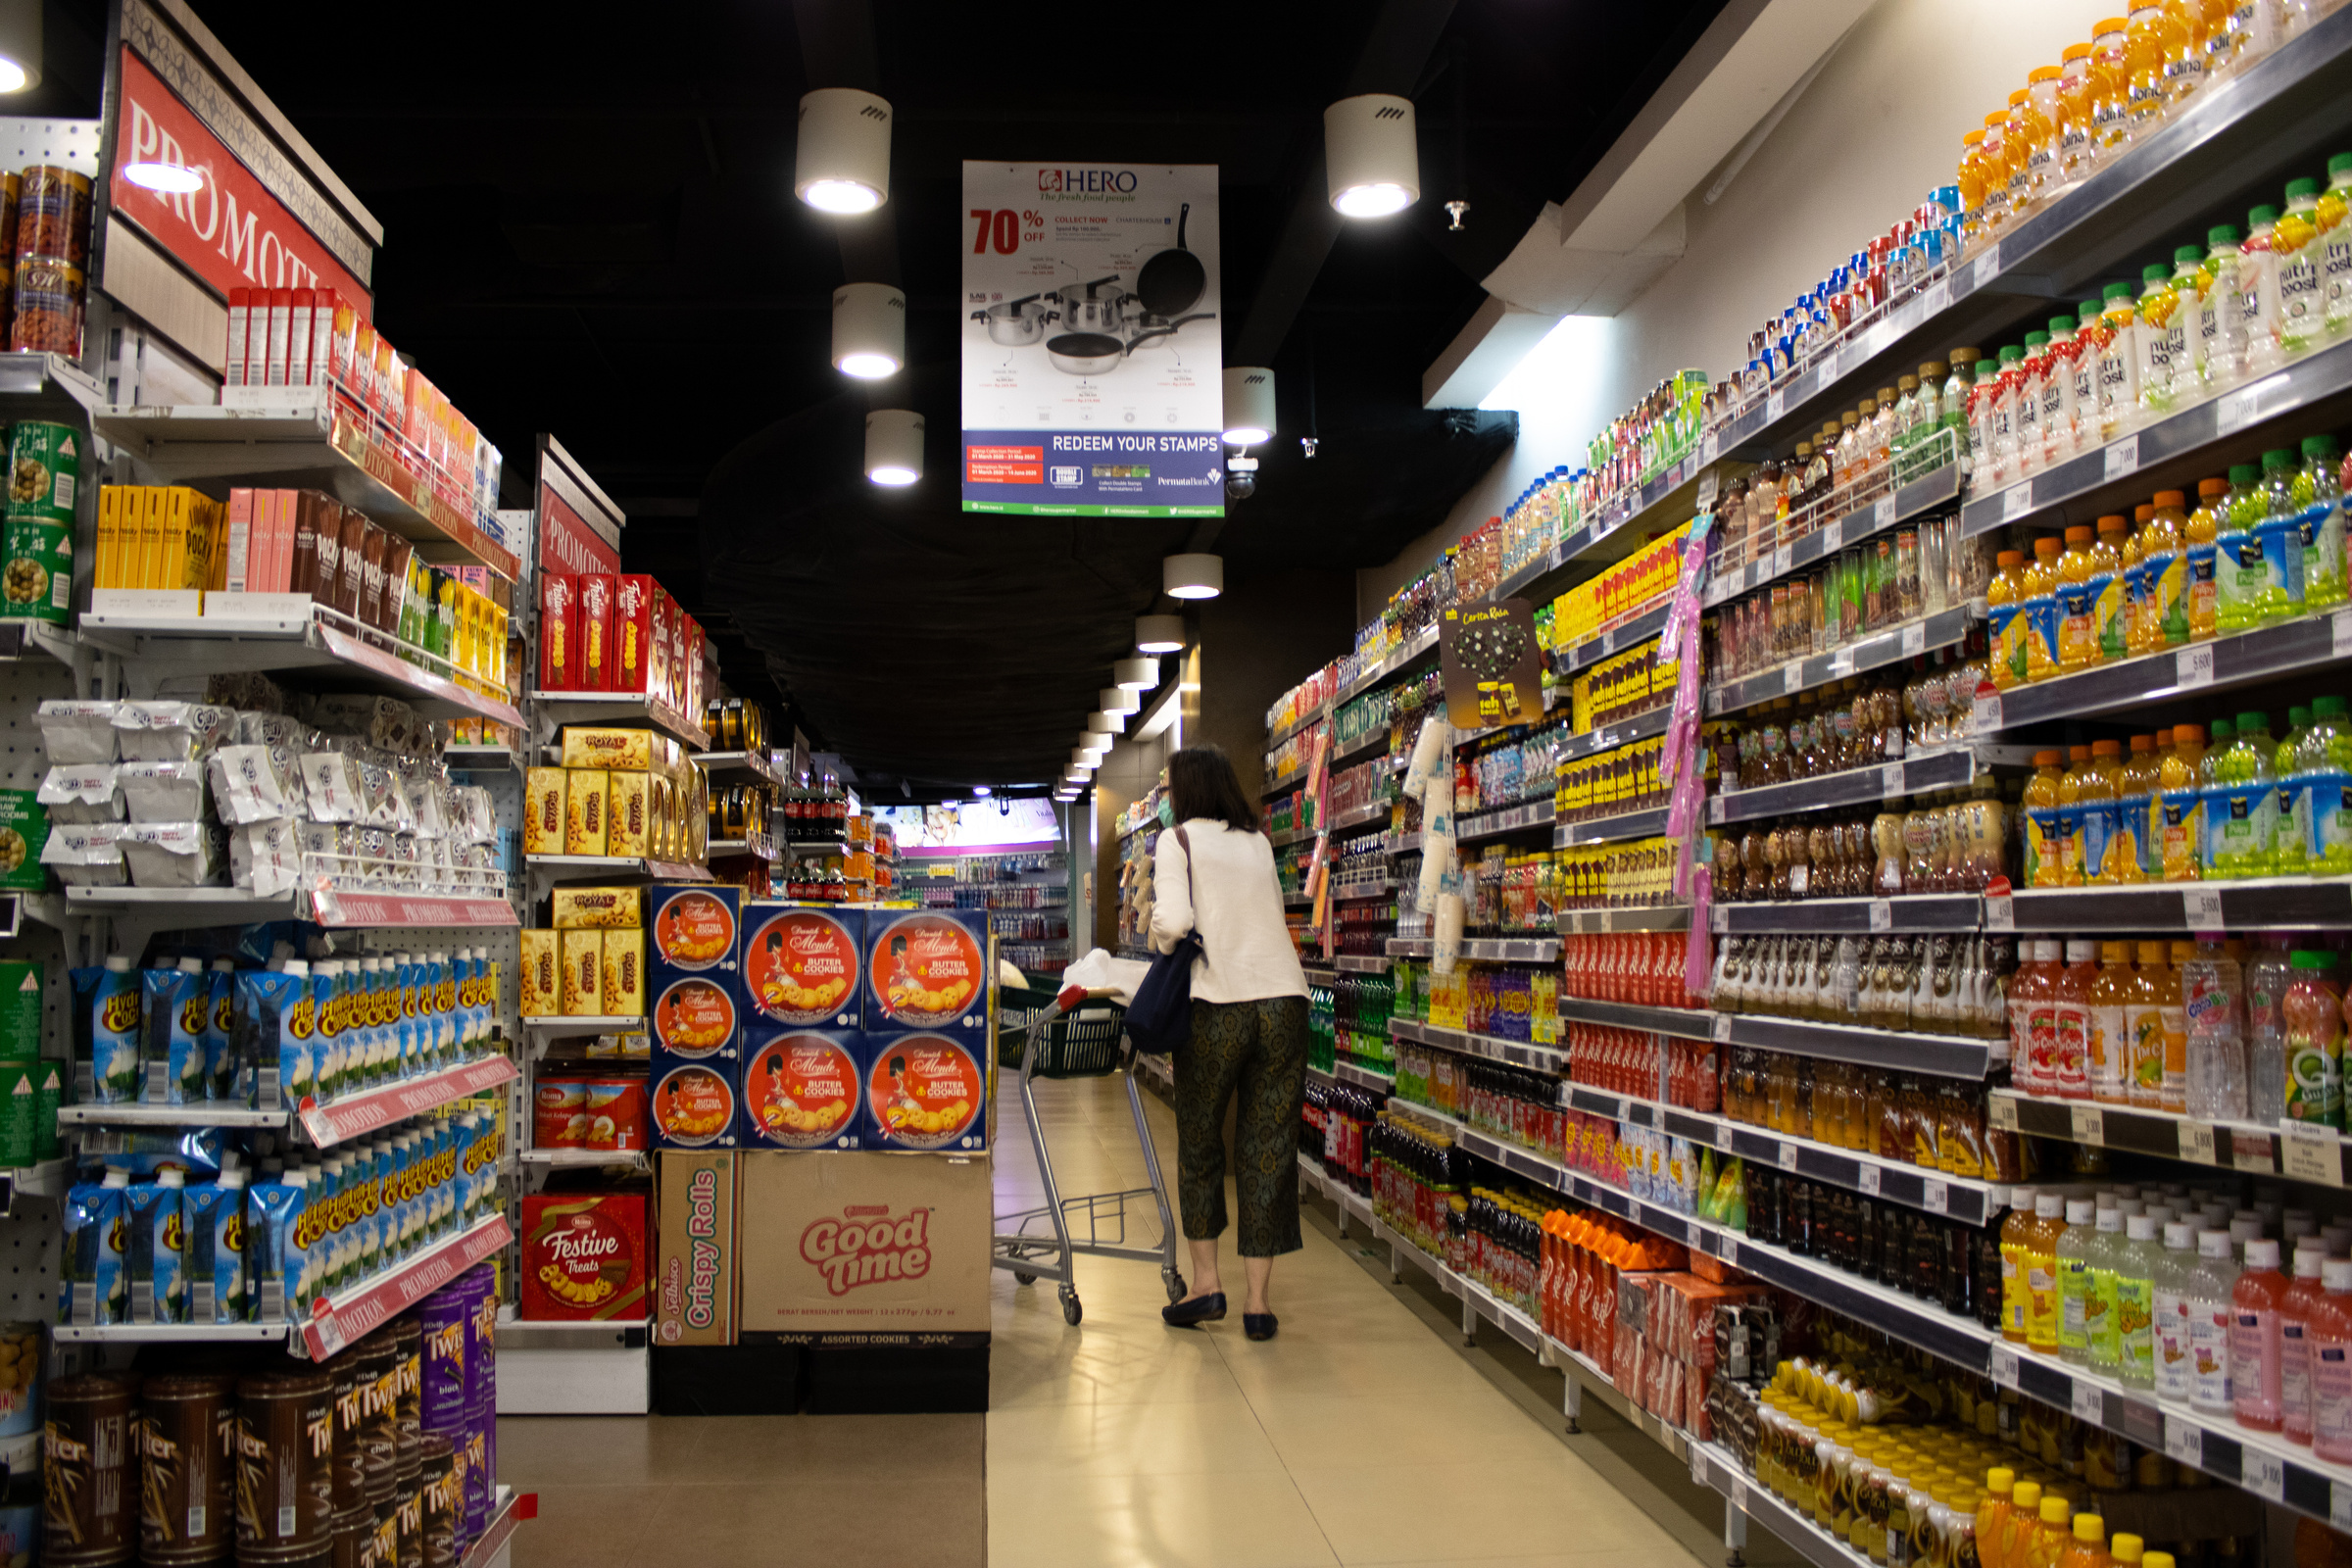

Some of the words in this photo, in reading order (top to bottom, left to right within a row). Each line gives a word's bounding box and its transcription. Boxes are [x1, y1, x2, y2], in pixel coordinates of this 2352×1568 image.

[1066, 170, 1138, 193] HERO
[1040, 193, 1054, 202] The
[1055, 193, 1082, 203] fresh
[1082, 193, 1104, 203] food
[1105, 193, 1136, 204] people
[1054, 216, 1088, 224] COLLECT
[1089, 216, 1108, 224] NOW
[1024, 232, 1046, 243] OFF
[1054, 435, 1113, 451] REDEEM
[1117, 436, 1156, 452] YOUR
[1159, 436, 1218, 452] STAMPS
[1055, 474, 1077, 483] STAMP
[1157, 476, 1210, 486] PermataBank
[472, 531, 511, 574] PROMOTION
[1490, 607, 1509, 619] Rasa
[587, 736, 626, 746] ROYAL
[549, 791, 560, 832] ROYAL
[590, 792, 600, 833] ROYAL
[633, 794, 643, 835] ROYAL
[576, 896, 613, 905] ROYAL
[2200, 897, 2220, 912] 5.600
[402, 904, 456, 922] PROMOTION
[791, 925, 819, 935] Danish
[914, 929, 944, 938] Danish
[790, 933, 835, 952] Monde
[913, 937, 959, 954] Monde
[544, 953, 553, 994] ROYAL
[585, 953, 595, 994] ROYAL
[626, 952, 636, 993] ROYAL
[804, 964, 845, 974] COOKIES
[928, 966, 969, 976] COOKIES
[791, 1048, 819, 1057] Danish
[913, 1049, 942, 1058] Danish
[790, 1055, 836, 1074] Monde
[911, 1057, 957, 1075] Monde
[805, 1087, 845, 1097] COOKIES
[808, 1080, 842, 1089] BUTTER
[927, 1088, 968, 1098] COOKIES
[399, 1080, 457, 1110] PROMOTION
[541, 1091, 563, 1102] Roma
[690, 1171, 715, 1236] Rolls
[462, 1224, 507, 1261] PROMOTION
[802, 1208, 927, 1263] Good
[542, 1227, 618, 1262] Festive
[565, 1257, 599, 1275] Treats
[820, 1247, 928, 1294] Time
[399, 1255, 453, 1301] PROMOTION
[688, 1241, 717, 1326] Crispy
[821, 1335, 868, 1344] ASSORTED
[870, 1335, 910, 1344] COOKIES
